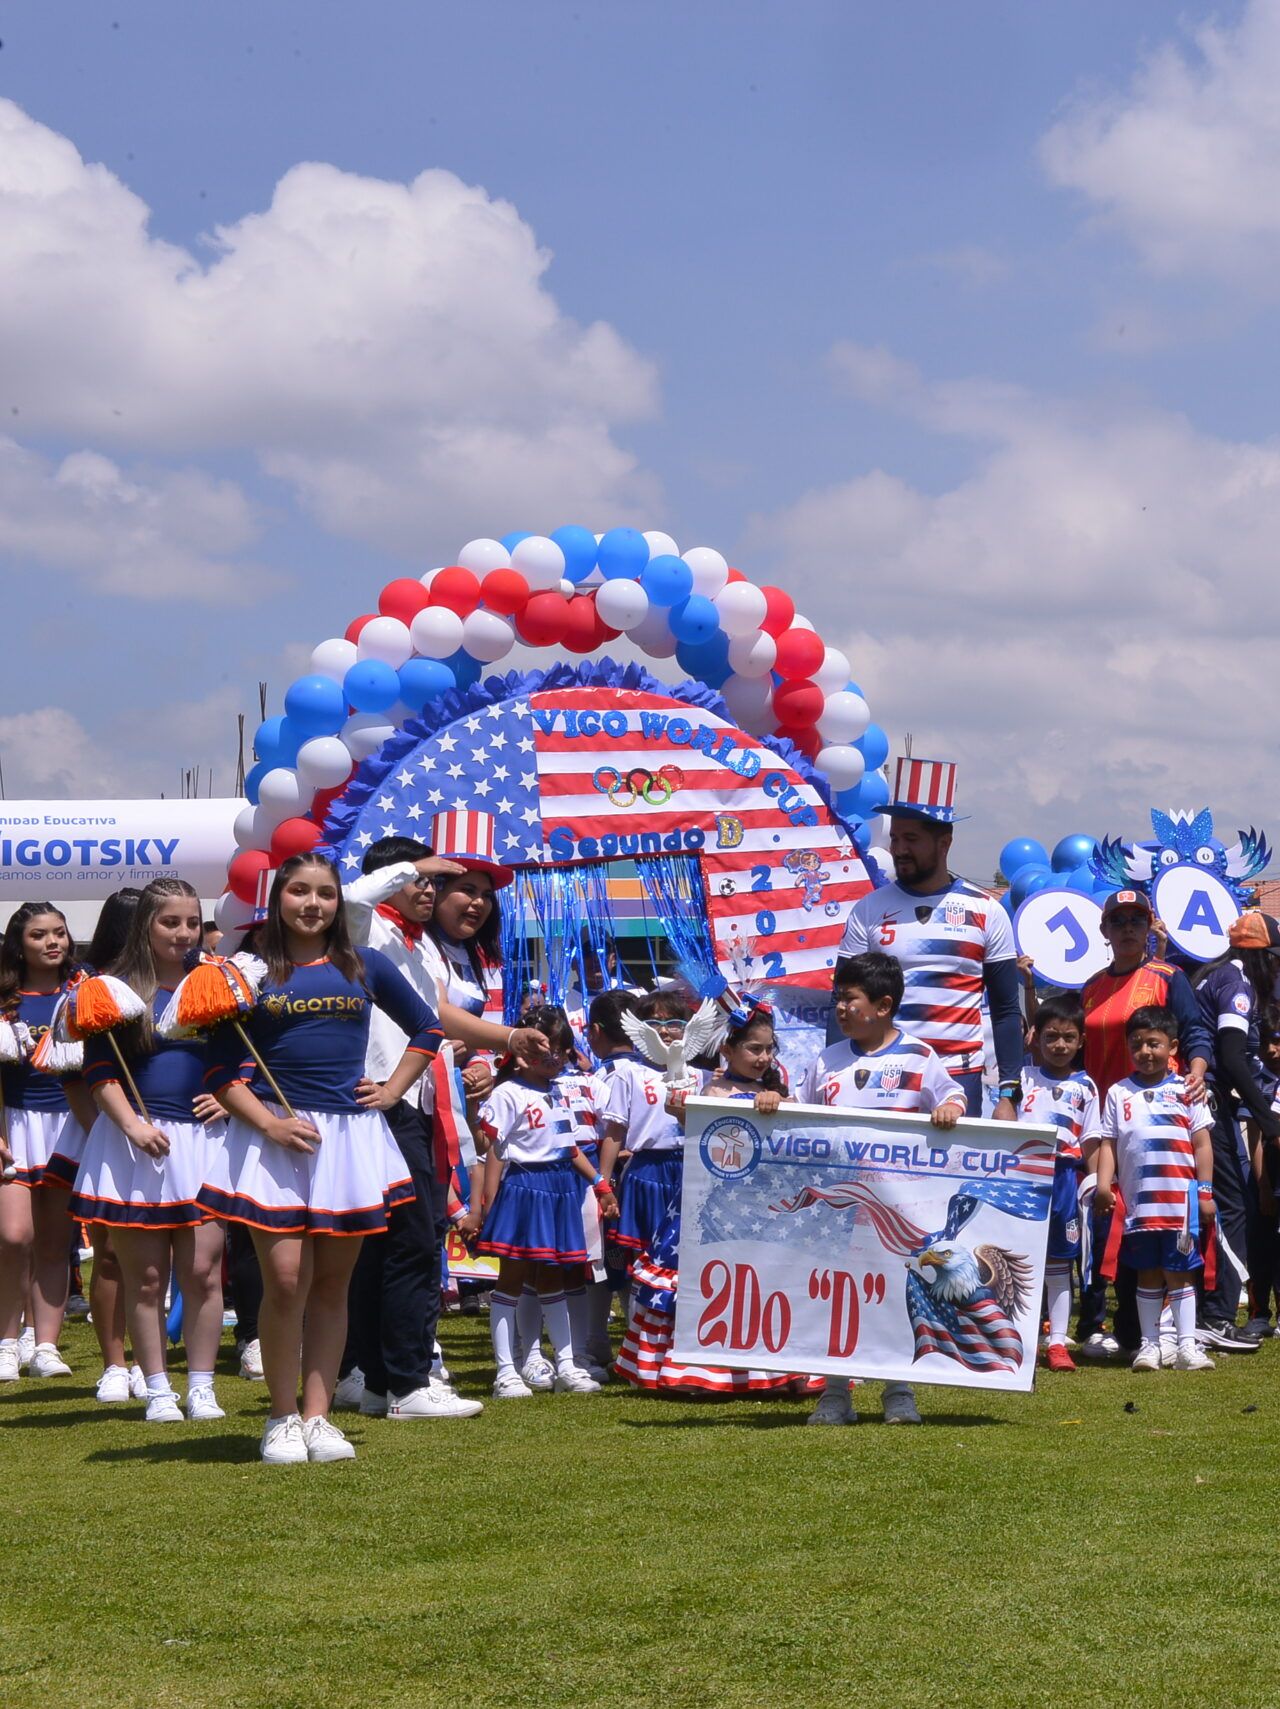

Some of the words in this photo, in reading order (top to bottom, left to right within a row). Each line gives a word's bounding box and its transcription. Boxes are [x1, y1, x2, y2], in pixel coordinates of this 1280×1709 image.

[530, 709, 628, 738] VIGO
[639, 711, 761, 778] WORLD
[763, 772, 818, 826] CUP
[548, 826, 705, 861] Segundo
[715, 815, 744, 849] D
[0, 838, 180, 867] IGOTSKY
[46, 871, 72, 880] con
[77, 870, 113, 880] amor
[117, 870, 126, 881] y
[130, 868, 179, 880] firmeza
[1177, 889, 1224, 936] A
[880, 920, 897, 945] 5
[644, 1085, 658, 1105] 6
[824, 1081, 840, 1106] 12
[1024, 1094, 1035, 1112] 2
[523, 1107, 545, 1130] 12
[1123, 1102, 1132, 1121] 8
[766, 1135, 831, 1158] VIGO
[844, 1140, 950, 1169] WORLD
[962, 1150, 1020, 1176] CUP
[697, 1260, 791, 1353] 2Do
